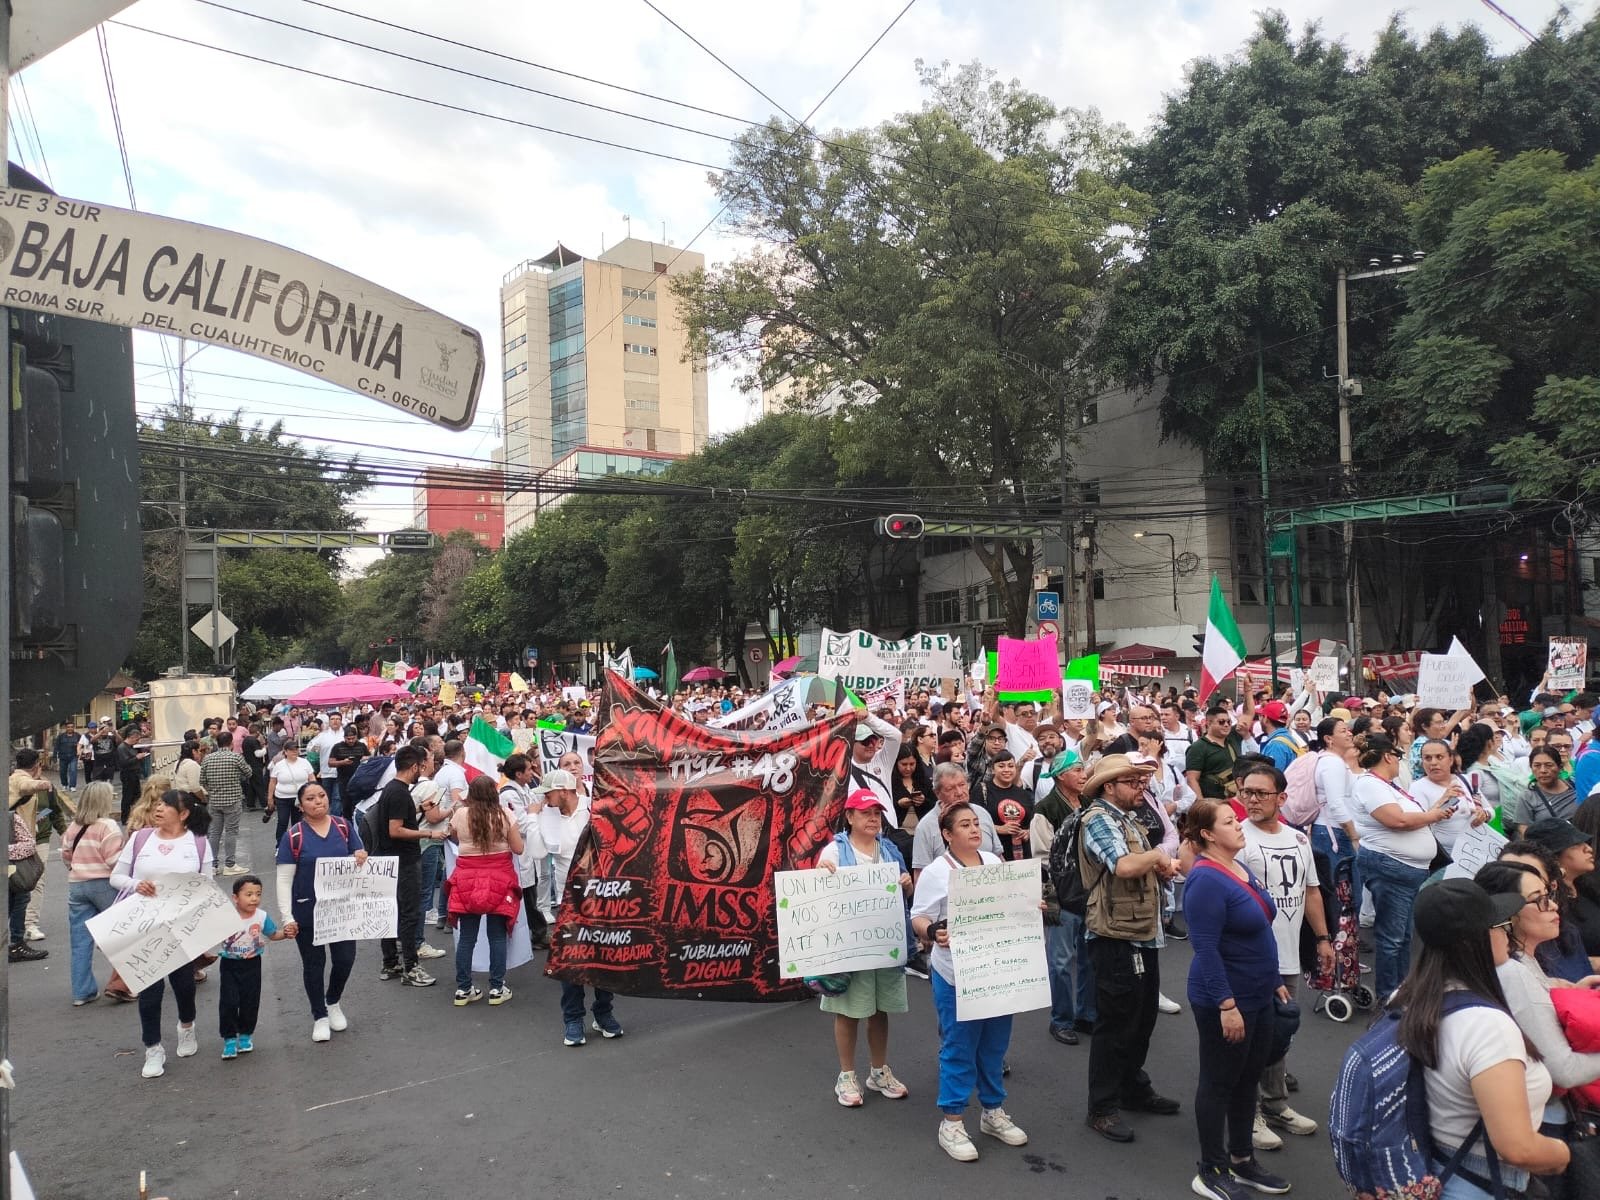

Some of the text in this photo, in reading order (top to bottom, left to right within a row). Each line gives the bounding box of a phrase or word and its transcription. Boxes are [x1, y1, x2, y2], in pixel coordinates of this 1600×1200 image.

[0, 190, 101, 222] EJE 3 SUR
[4, 287, 104, 317] ROMA SUR
[10, 220, 403, 380] BAJA CALIFORNIA
[141, 311, 326, 374] DEL. CUAUHTEMOC
[357, 376, 438, 419] C.P. 06760
[823, 656, 850, 667] IMSS
[366, 858, 397, 879] SOCIAL
[583, 879, 631, 898] FUERA
[782, 877, 807, 897] UN
[814, 872, 864, 892] MEJOR
[580, 896, 642, 918] OLIVOS
[661, 885, 760, 931] IMSS
[791, 895, 898, 927] NOS BENEFICIA
[576, 927, 631, 946] INSUMOS
[850, 921, 904, 942] TODOS
[561, 943, 653, 960] PARA TRABAJAR
[680, 940, 752, 961] JUBILACIÓN
[684, 959, 741, 980] DIGNA
